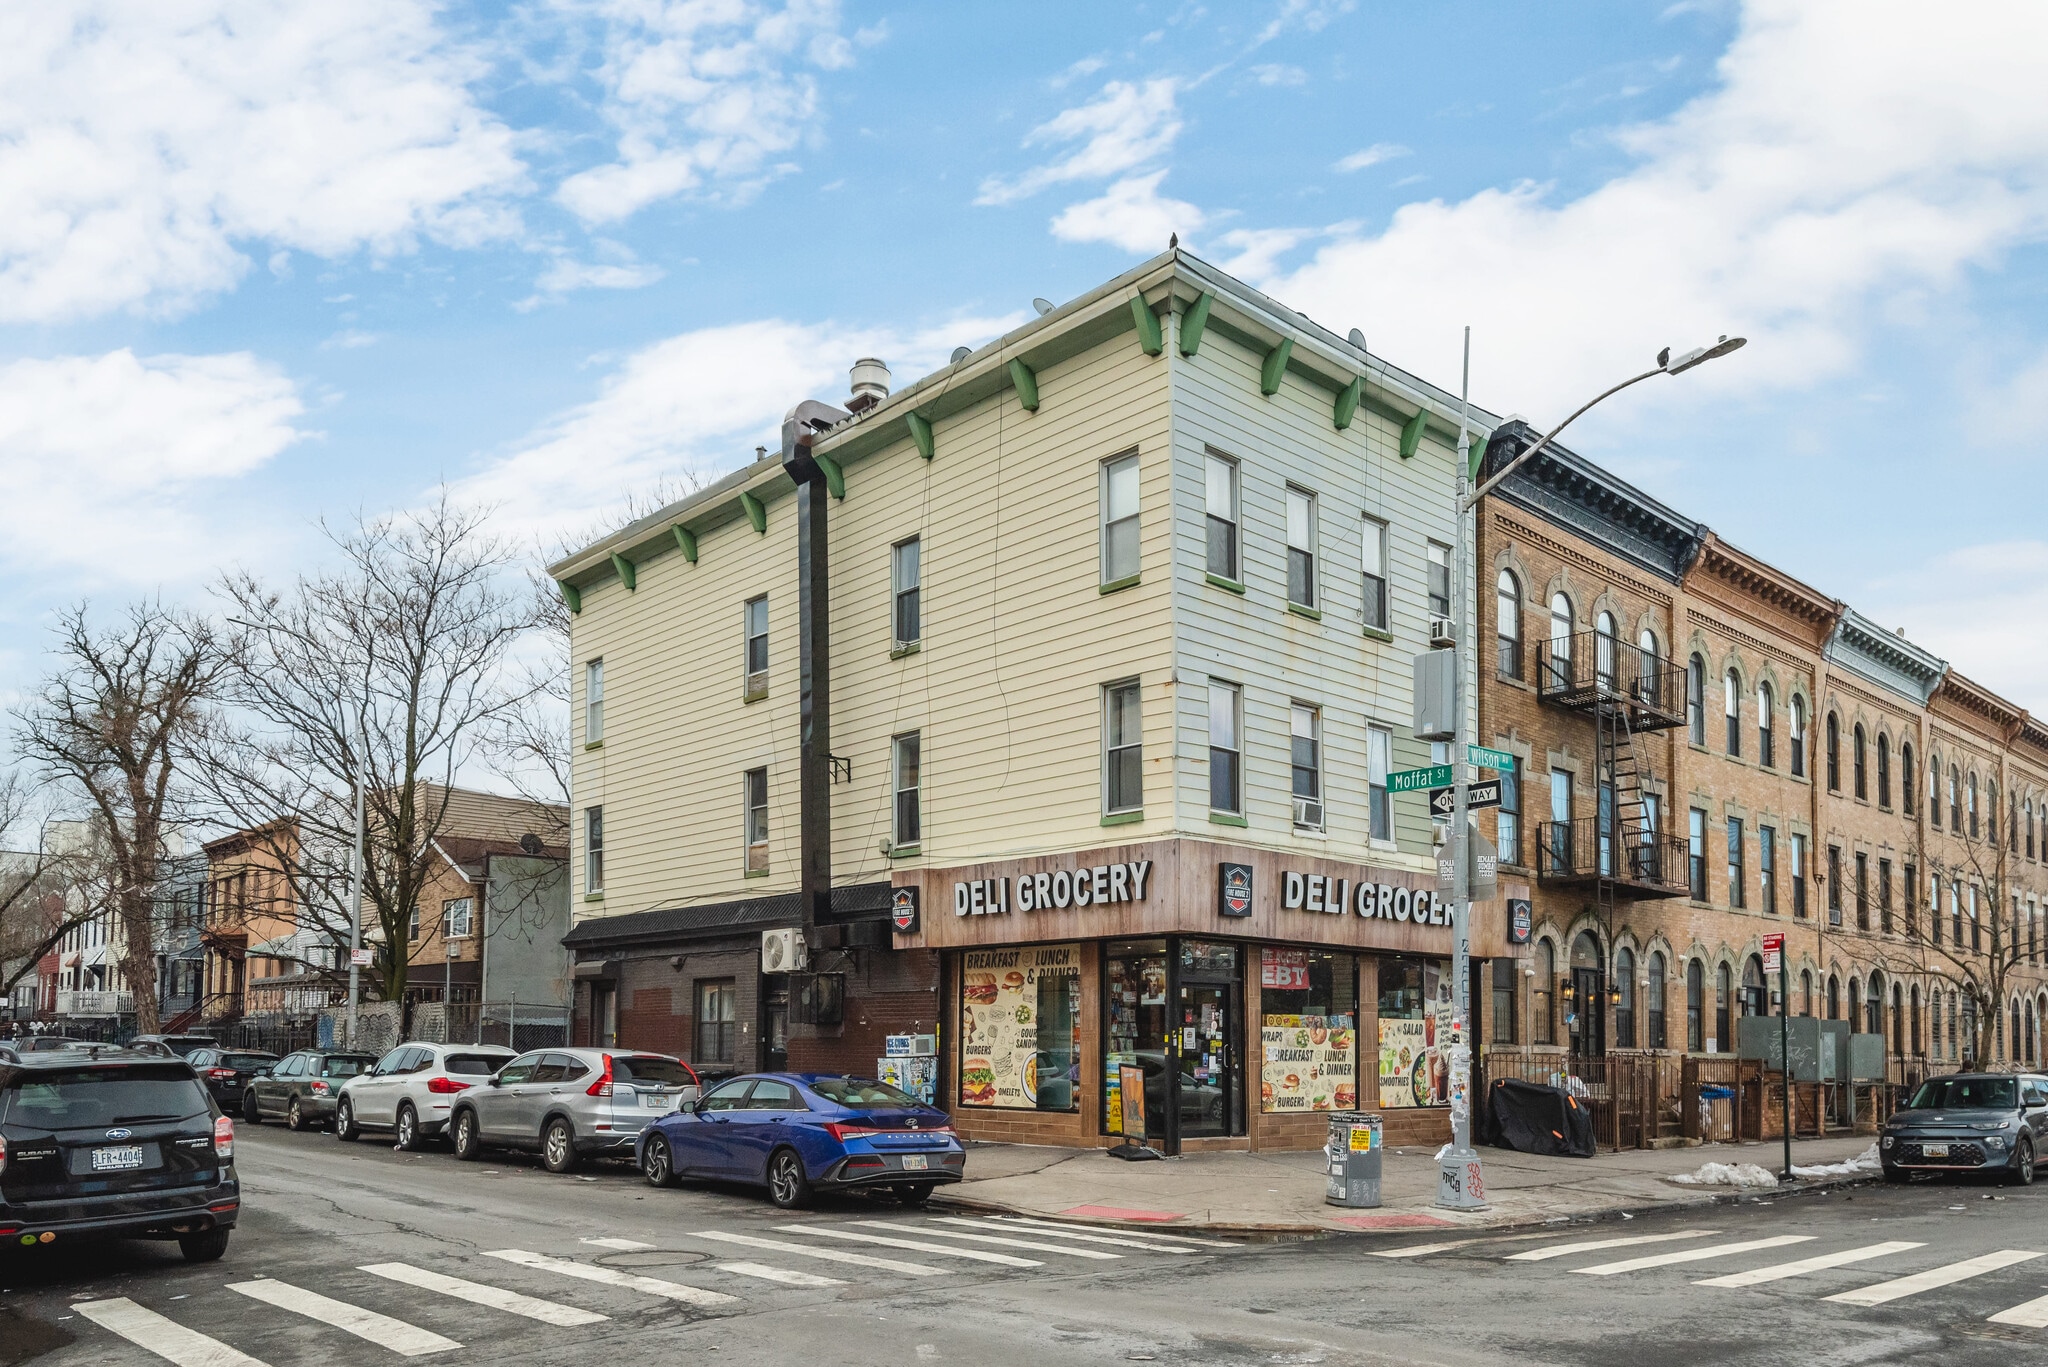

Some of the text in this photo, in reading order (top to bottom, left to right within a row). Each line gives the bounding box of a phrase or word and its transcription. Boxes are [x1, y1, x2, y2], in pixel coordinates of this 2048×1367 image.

[1470, 747, 1499, 767] Wilson
[1395, 769, 1445, 789] Moffat St
[1440, 789, 1492, 807] ON WAY
[954, 860, 1151, 917] DELI GROCERY
[1284, 870, 1473, 926] DELI GROCE
[967, 949, 1070, 969] BREAKFAST LUNCH
[1027, 968, 1035, 984] &
[1262, 965, 1306, 986] EBT
[1403, 1023, 1423, 1035] SALAD
[1262, 1031, 1283, 1042] WRAPS
[966, 1045, 992, 1055] BURGERS
[1324, 1050, 1346, 1062] LUNCH
[1319, 1063, 1351, 1076] & DINNER
[1380, 1076, 1409, 1087] SMOOTHIES
[998, 1087, 1021, 1097] OMELETS
[1277, 1096, 1305, 1108] BURGERS
